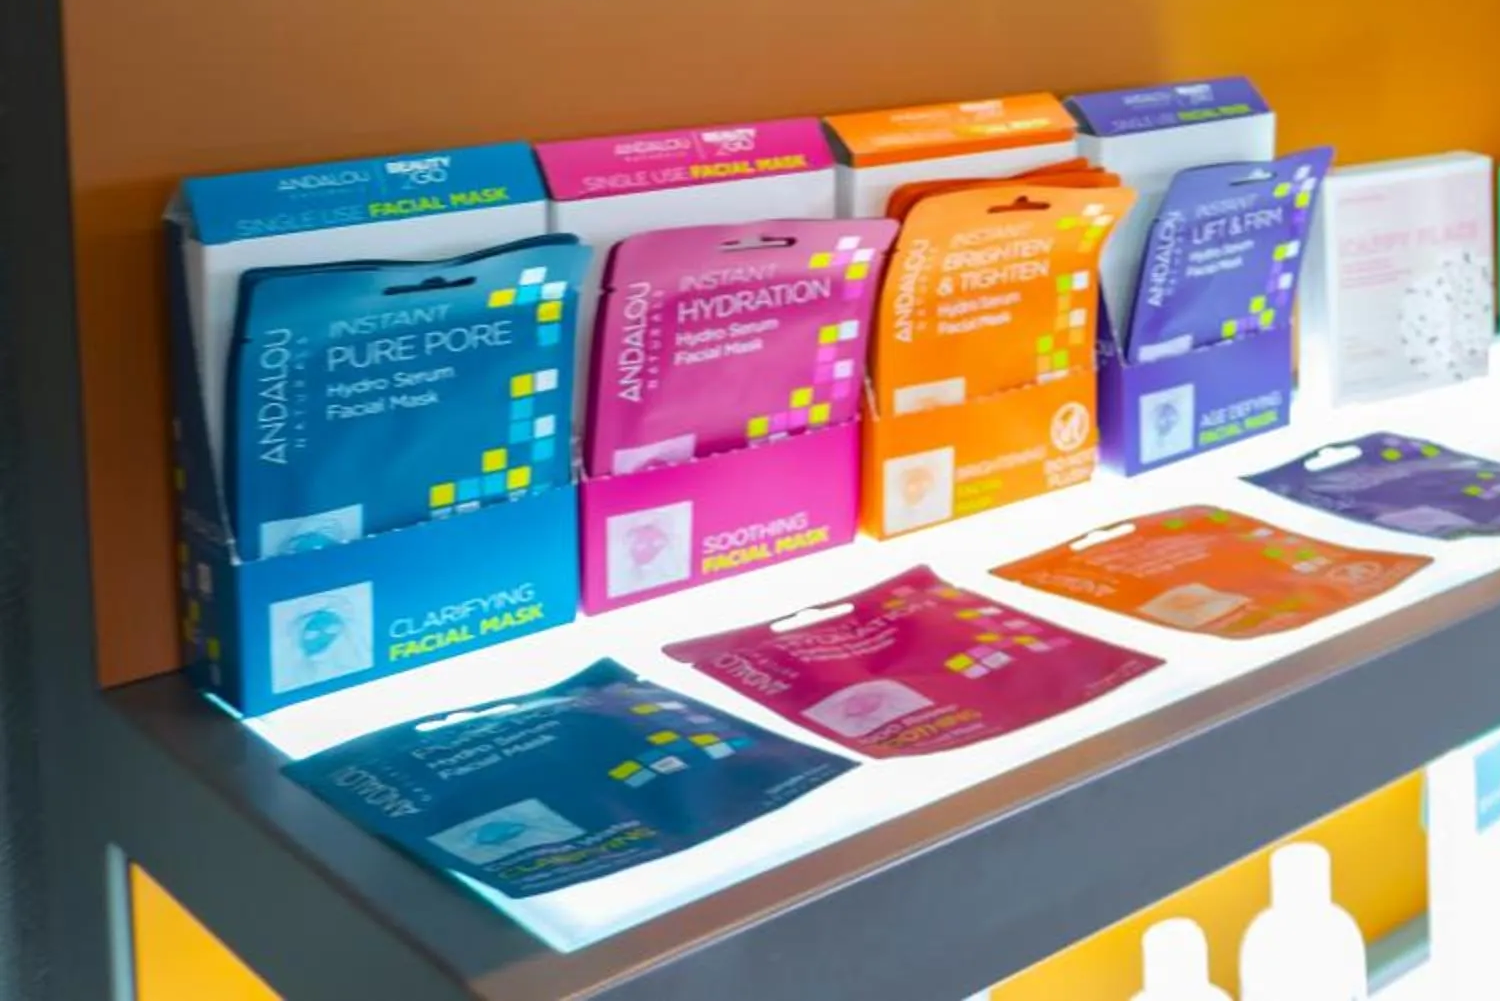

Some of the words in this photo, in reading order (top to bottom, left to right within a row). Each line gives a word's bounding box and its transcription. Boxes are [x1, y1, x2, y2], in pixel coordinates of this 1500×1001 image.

[368, 196, 446, 219] FACIAL
[449, 186, 509, 209] MASK
[328, 303, 453, 338] INSTANT
[676, 278, 832, 324] HYDRATION
[326, 336, 418, 371] PURE
[424, 320, 513, 354] PORE
[617, 282, 652, 402] ANDALOU
[258, 328, 292, 465] ANDALOU
[326, 375, 389, 399] Hydro
[393, 367, 455, 389] Serum
[326, 396, 385, 420] Facial
[388, 389, 439, 411] Mask
[702, 511, 810, 554] SOOTHING
[389, 582, 535, 639] CLARIFYING
[389, 627, 474, 661] FACIAL
[480, 603, 543, 636] MASK
